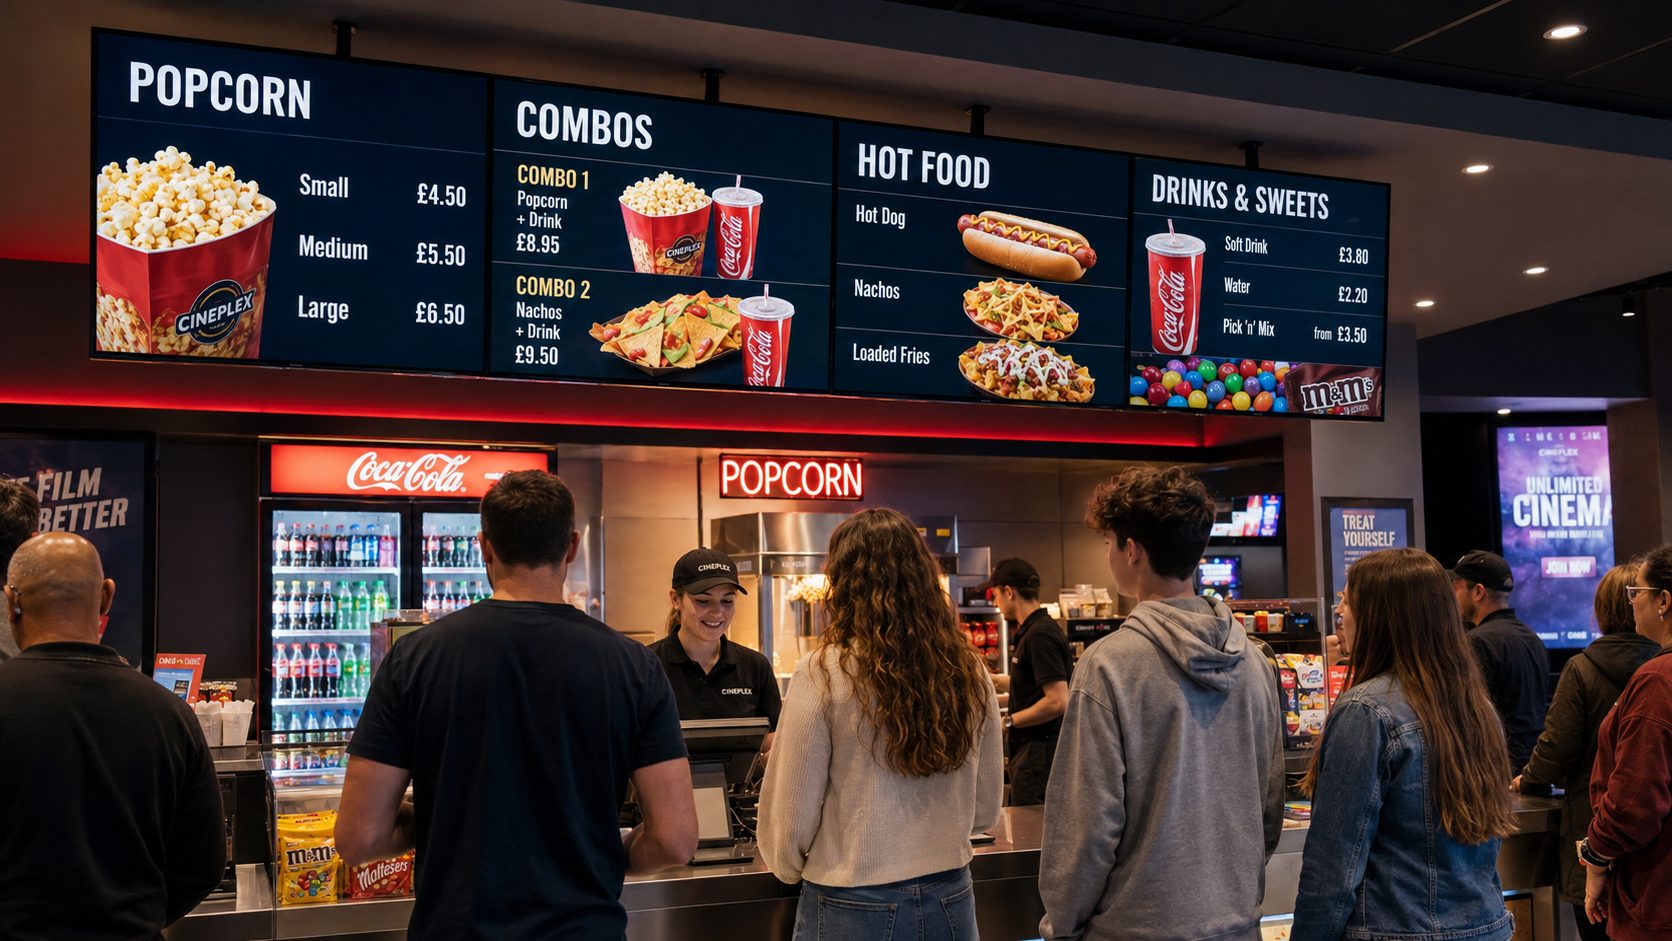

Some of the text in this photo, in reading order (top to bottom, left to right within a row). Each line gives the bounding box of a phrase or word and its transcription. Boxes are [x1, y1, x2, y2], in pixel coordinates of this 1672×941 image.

[130, 61, 310, 119] POPCORN
[517, 101, 652, 149] COMBOS
[518, 165, 588, 189] COMBO 1
[859, 143, 989, 188] HOT FOOD
[300, 174, 466, 207] Small £4.50
[517, 190, 568, 210] Popcorn
[1153, 174, 1328, 219] DRINKS & SWEETS
[517, 212, 562, 229] + Drink
[856, 205, 905, 229] Hot Dog
[300, 235, 465, 266] Medium £5.50
[517, 233, 559, 253] £8.95
[720, 211, 743, 276] Coca-Cola
[1225, 236, 1368, 264] Soft Drink £3.80
[517, 276, 590, 299] COMBO 2
[855, 279, 899, 299] Nachos
[1225, 277, 1367, 303] Water £2.20
[178, 292, 253, 332] CINEPLEX
[299, 295, 464, 325] Large £6.50
[517, 302, 562, 319] Nachos
[1158, 263, 1185, 351] Coca-Cola
[516, 323, 560, 339] + Drink
[1224, 318, 1242, 334] Pick
[1259, 321, 1274, 336] Mix
[1314, 326, 1332, 340] from
[1338, 326, 1366, 343] £3.50
[515, 345, 558, 365] £9.50
[854, 343, 930, 364] Loaded Fries
[37, 467, 102, 503] FILM
[346, 451, 471, 492] Coca-Cola
[722, 459, 862, 496] POPCORN
[1526, 476, 1604, 495] UNLIMITED
[38, 497, 129, 534] BETTER
[1342, 514, 1375, 530] TREAT
[1343, 530, 1395, 547] YOURSELF
[357, 861, 408, 891] Maltesers
